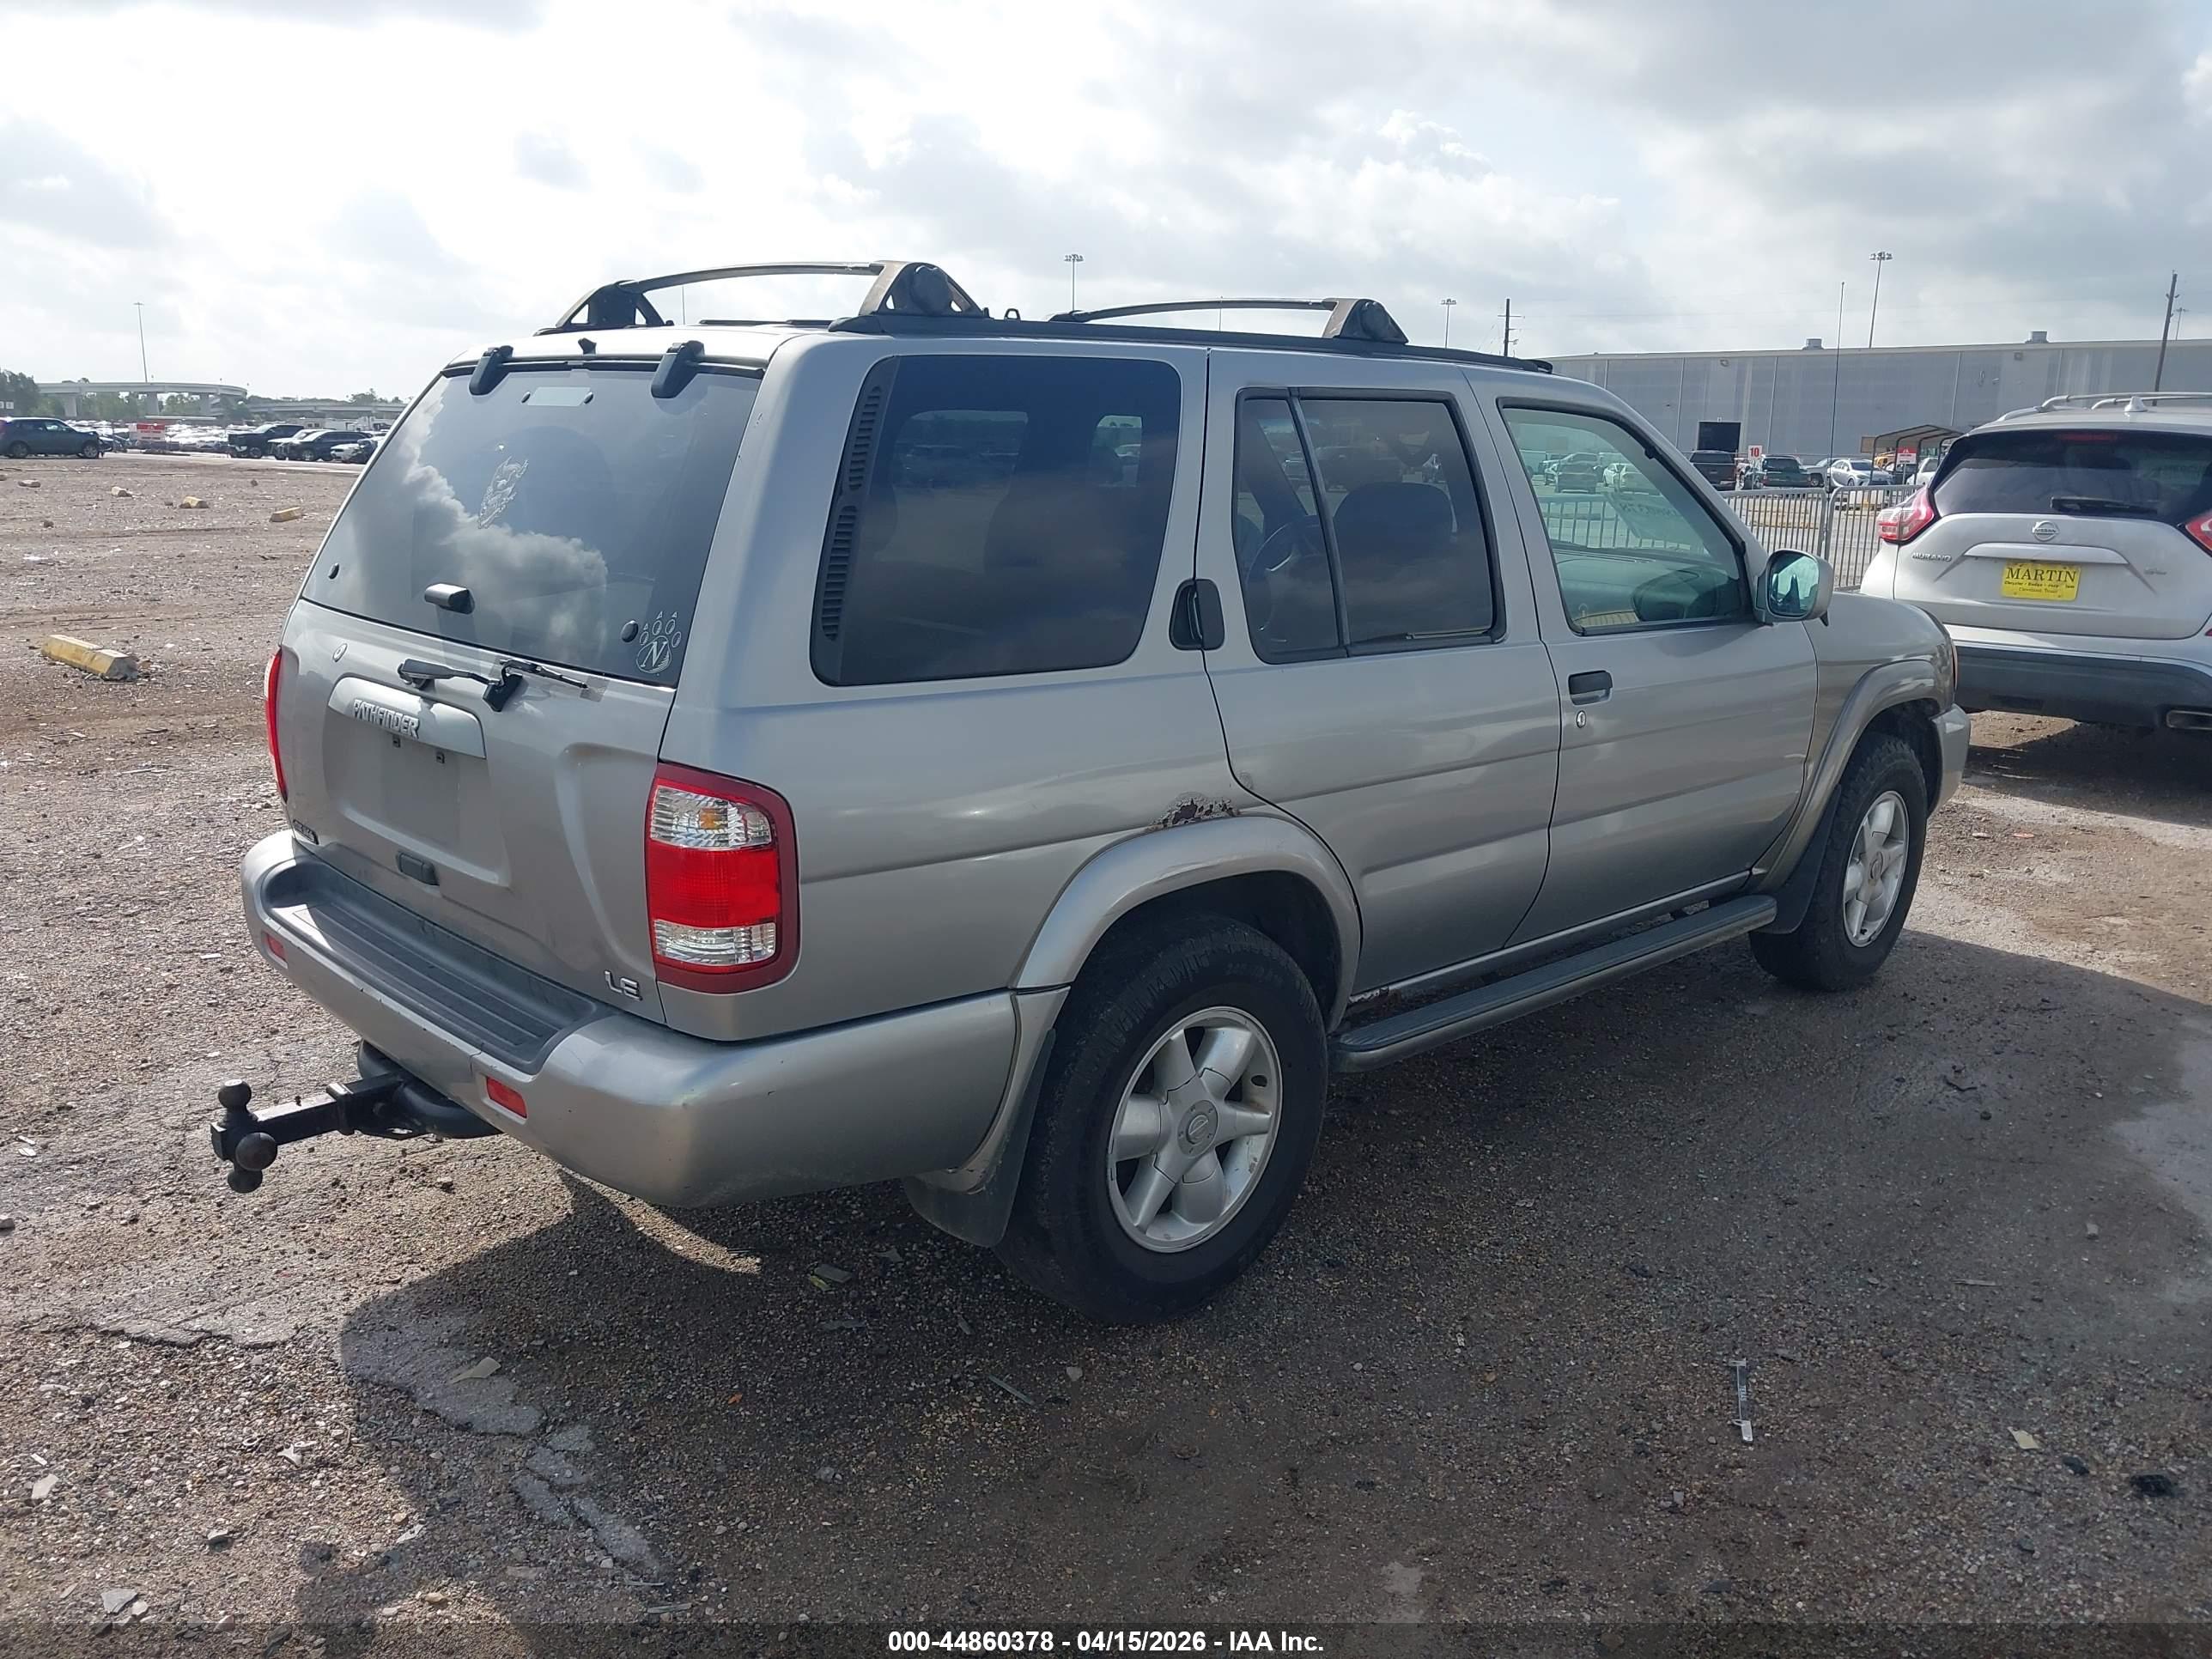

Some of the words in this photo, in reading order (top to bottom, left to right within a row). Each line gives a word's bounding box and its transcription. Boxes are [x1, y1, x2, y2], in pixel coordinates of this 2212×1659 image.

[1749, 447, 1759, 458] 10
[1911, 552, 1952, 562] MURANO
[2005, 567, 2076, 583] MARTIN
[640, 641, 669, 668] N
[353, 698, 420, 739] PATHFINDER
[604, 970, 640, 1000] LE
